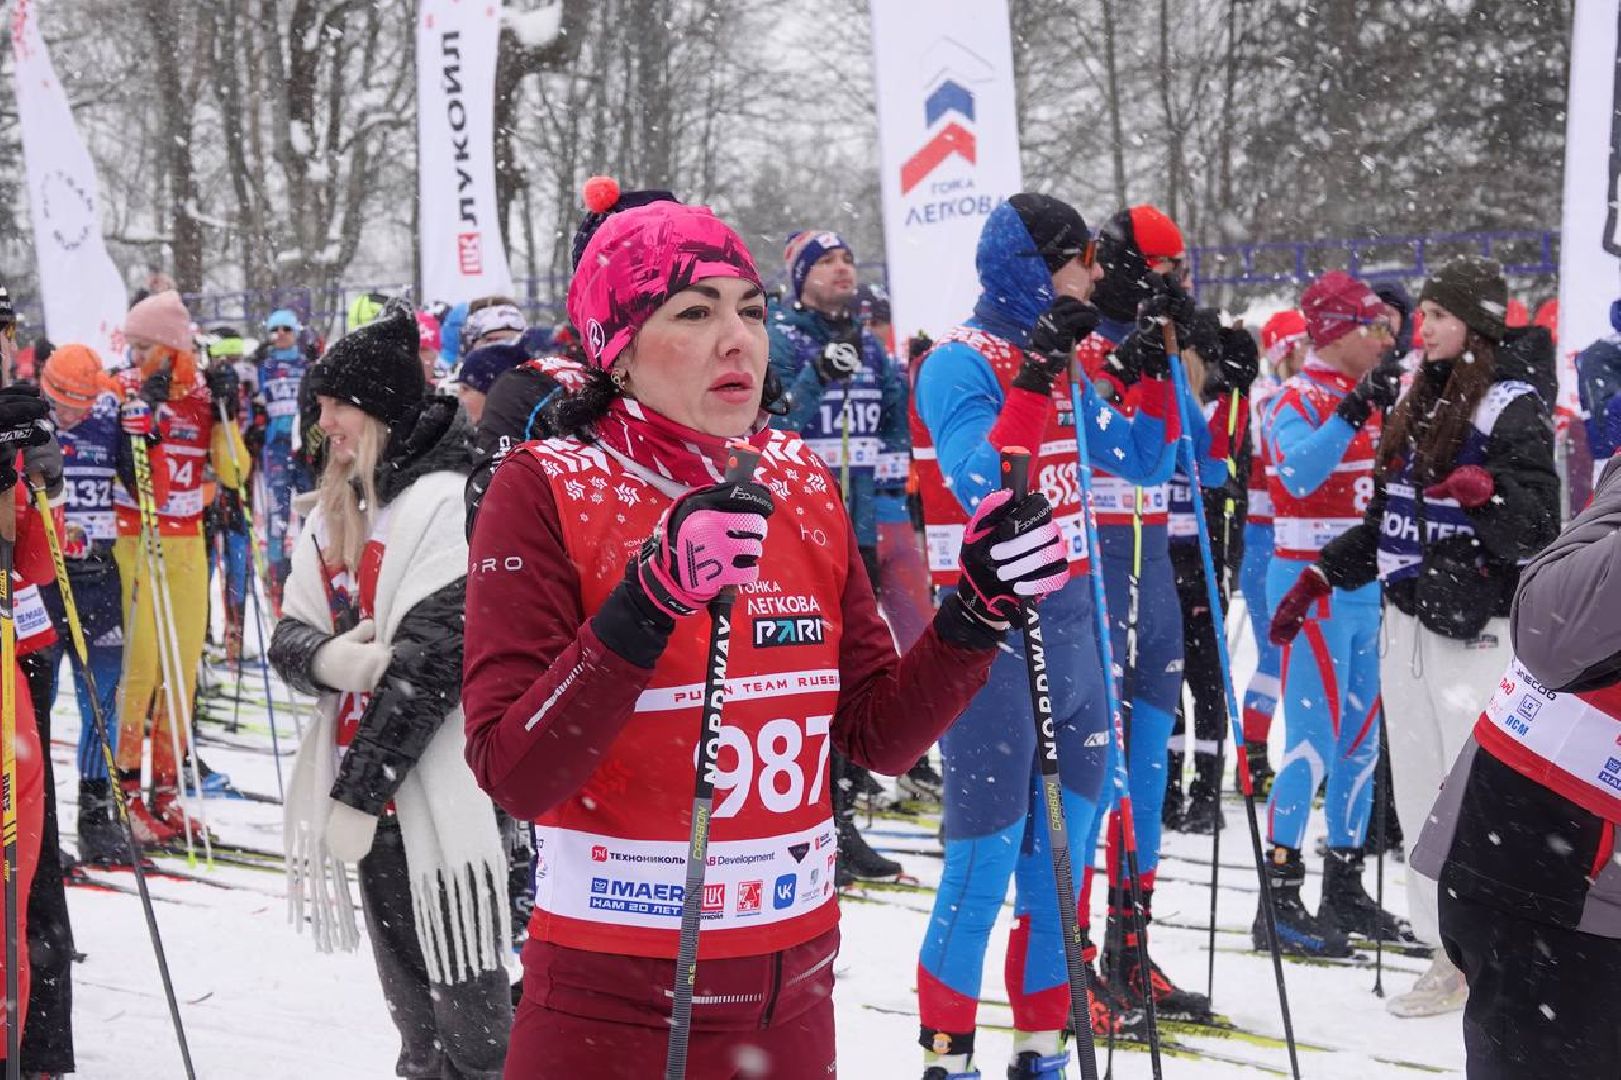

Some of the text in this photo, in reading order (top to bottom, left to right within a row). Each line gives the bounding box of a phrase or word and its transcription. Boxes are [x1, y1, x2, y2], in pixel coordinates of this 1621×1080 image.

[440, 28, 477, 228] ЛУКОЙЛ
[820, 402, 881, 434] 1419
[747, 595, 821, 616] ЛЕГКОВА
[756, 618, 822, 645] PARI
[743, 680, 788, 693] TEAM
[1027, 606, 1058, 760] NORDWAY
[703, 615, 731, 788] NORDWAY
[693, 713, 832, 818] 987
[609, 852, 686, 864] ТЕХНОНИКОЛЬ
[717, 852, 776, 865] Development
[611, 880, 686, 902] MAER
[592, 899, 681, 916] НАМ 20 ЛЕТ
